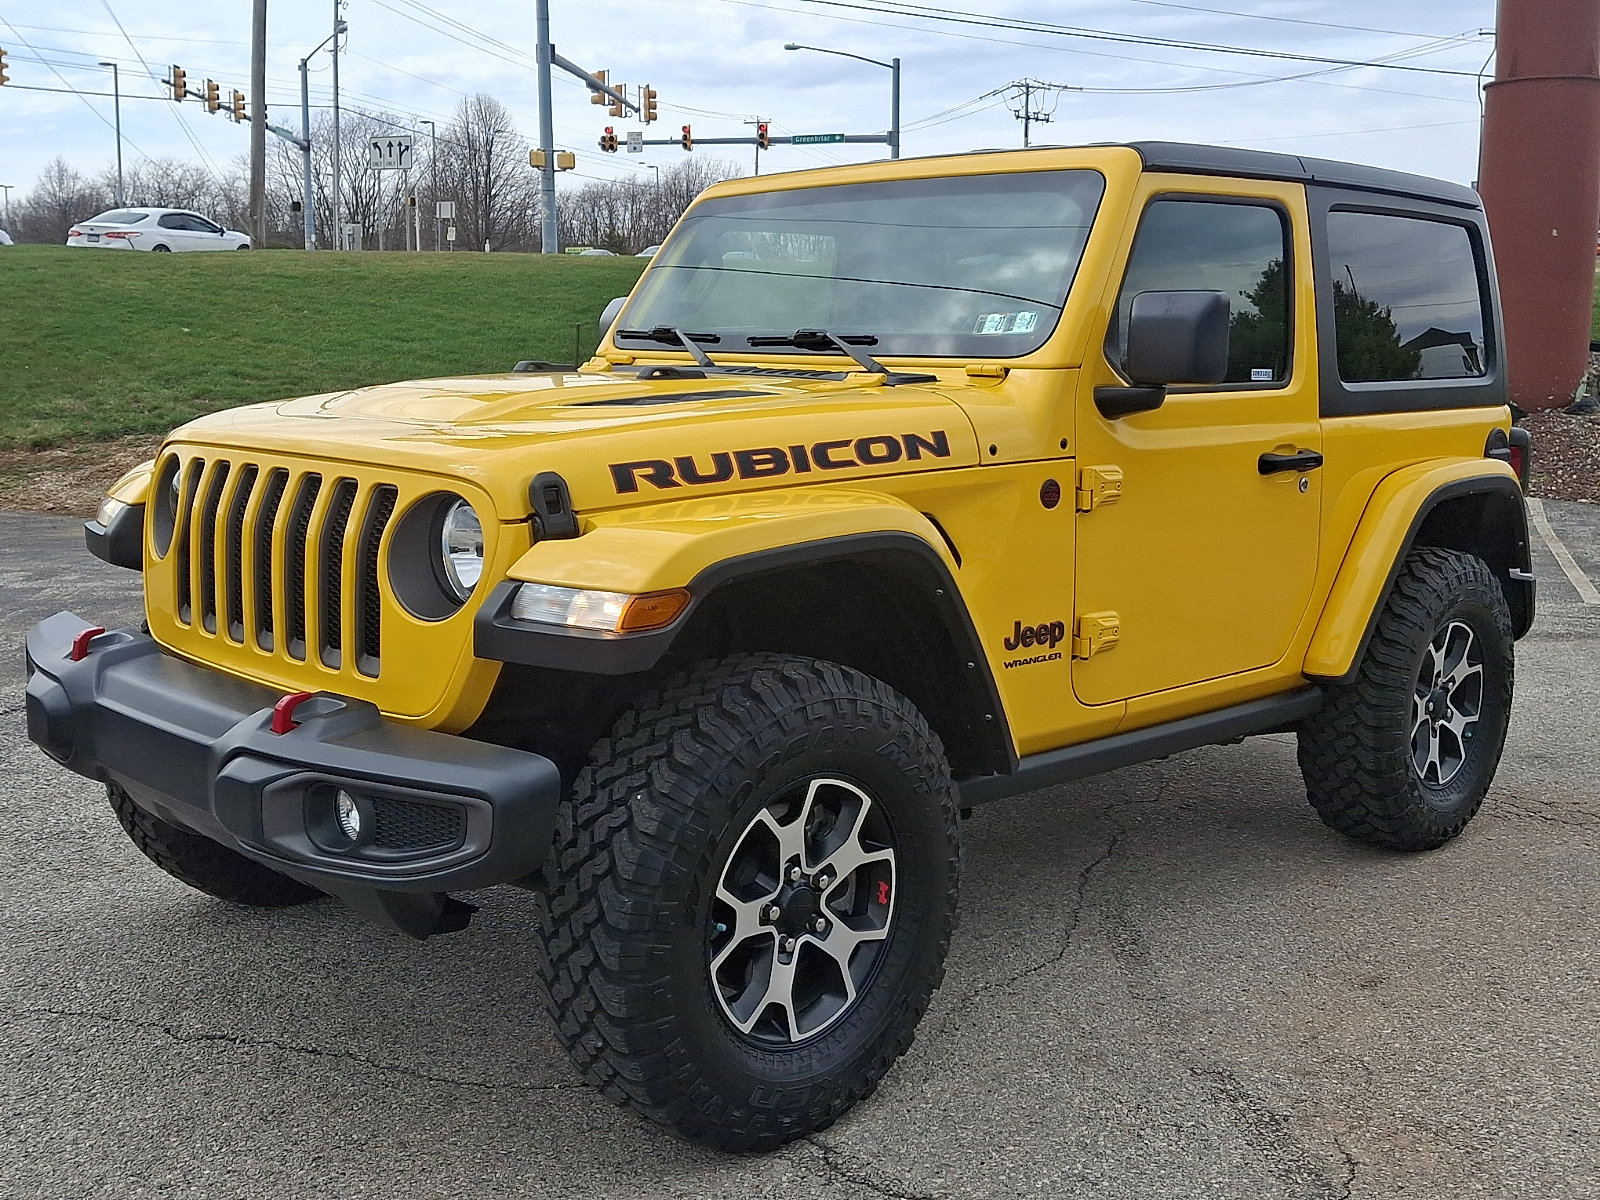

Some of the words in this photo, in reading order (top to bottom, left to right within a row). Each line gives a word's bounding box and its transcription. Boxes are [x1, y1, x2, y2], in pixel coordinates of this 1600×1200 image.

[608, 430, 951, 494] RUBICON
[1003, 620, 1065, 651] Jeep
[1003, 652, 1063, 669] WRANGLER
